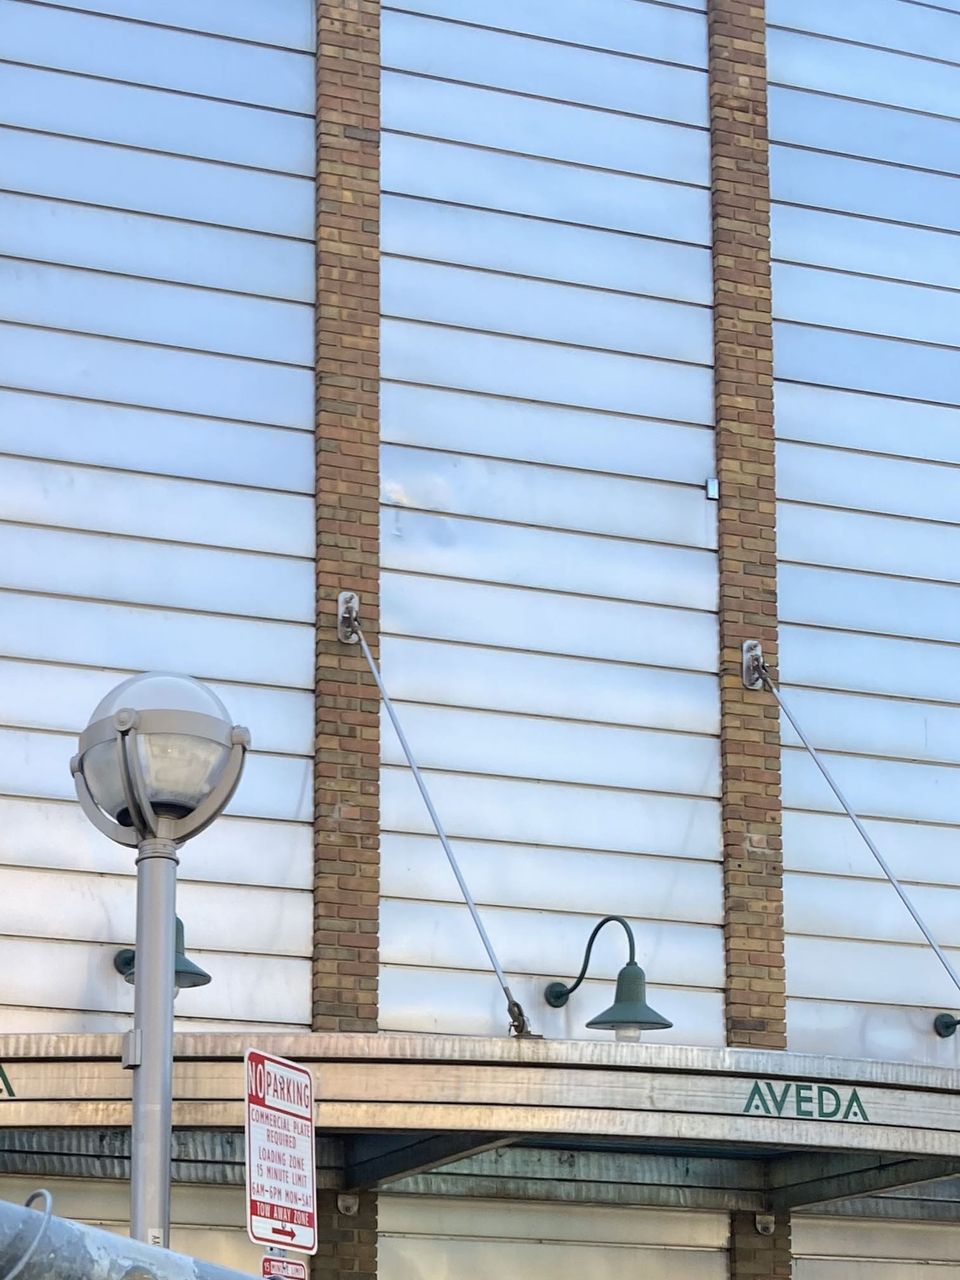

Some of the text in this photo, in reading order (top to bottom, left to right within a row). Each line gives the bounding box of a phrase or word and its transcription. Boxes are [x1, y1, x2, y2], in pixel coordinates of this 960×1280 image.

[248, 1061, 310, 1109] NO PARKING
[743, 1080, 869, 1121] AVEDA
[251, 1108, 311, 1138] COMMERCIAL PLATE
[266, 1128, 297, 1149] REQUIRED
[258, 1146, 305, 1171] LOADING ZONE
[256, 1163, 307, 1188] 15 MINUTE LIMIT
[256, 1201, 310, 1226] TOW AWAY ZONE
[263, 1261, 271, 1272] 15
